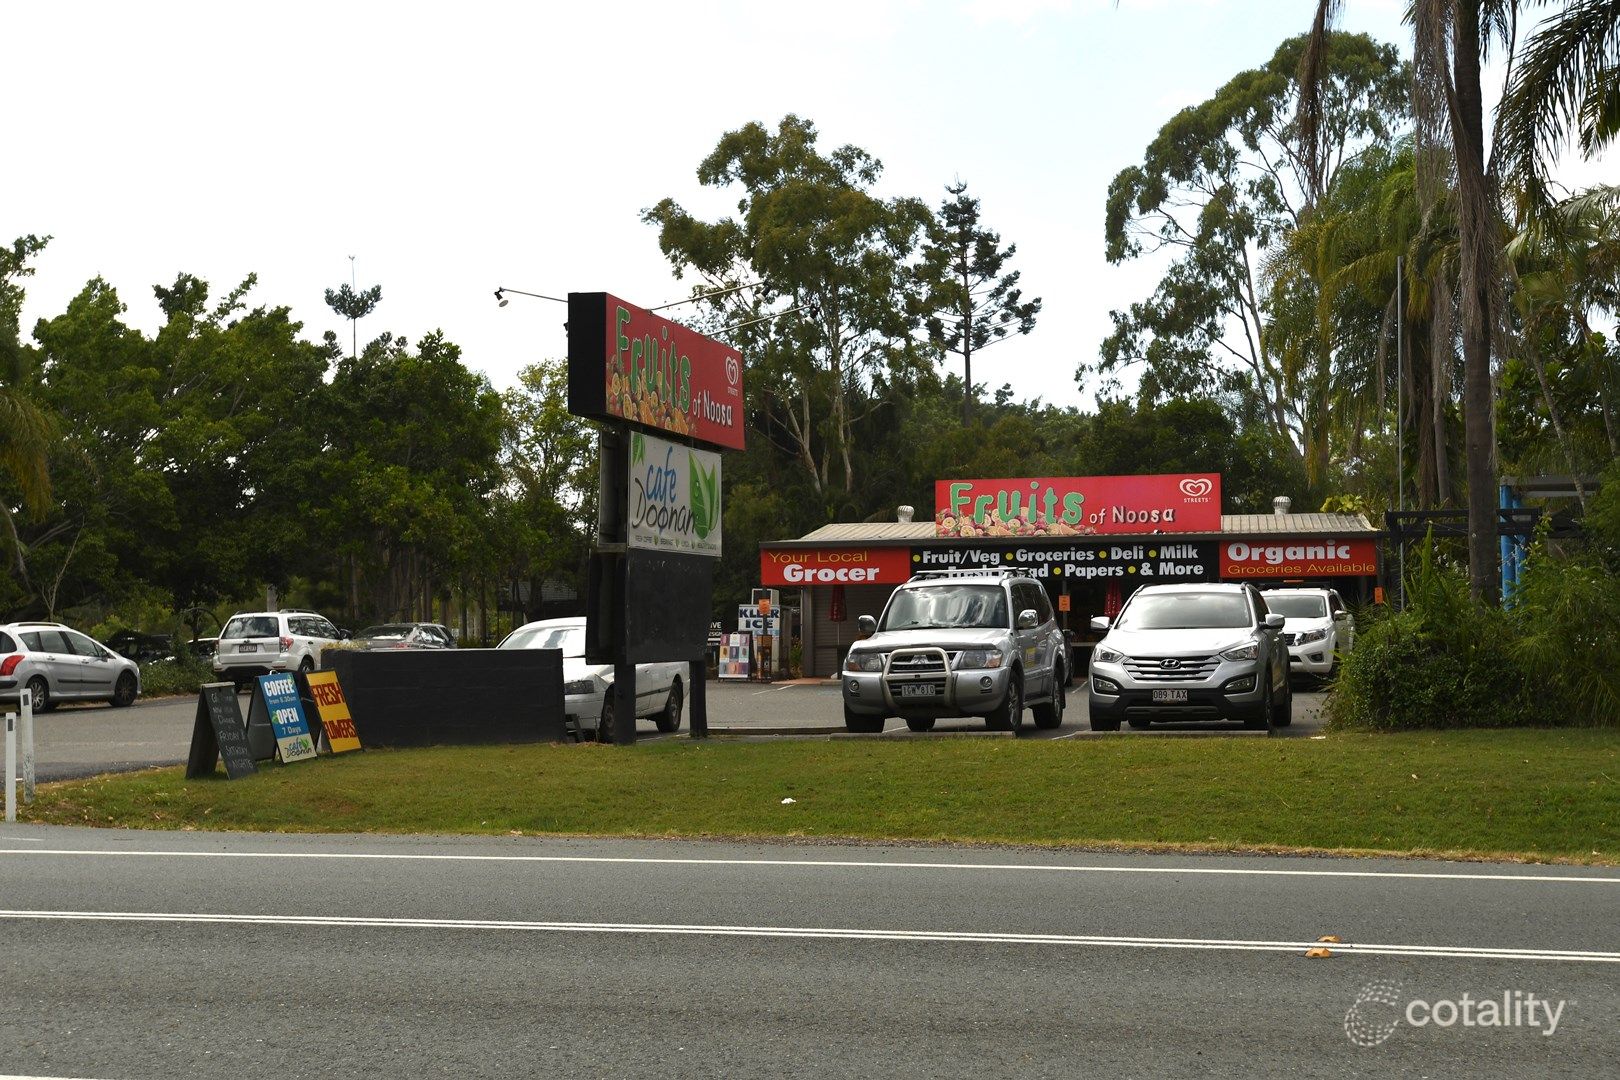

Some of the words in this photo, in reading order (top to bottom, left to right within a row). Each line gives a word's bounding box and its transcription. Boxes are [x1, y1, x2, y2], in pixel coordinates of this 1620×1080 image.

[616, 305, 691, 414] Fruits
[692, 391, 702, 417] of
[703, 389, 733, 426] Noosa
[631, 477, 695, 535] Doonan
[949, 481, 1085, 525] Fruits
[1089, 508, 1107, 524] of
[1112, 505, 1176, 523] Noosa
[768, 552, 811, 563] Your
[817, 550, 868, 562] Local
[922, 549, 1000, 565] Fruit/Veg
[1015, 548, 1095, 562] Groceries
[1110, 546, 1144, 560] Deli
[1160, 545, 1199, 559] Milk
[1227, 539, 1350, 565] Organic
[783, 564, 880, 582] Grocer
[1065, 562, 1124, 579] Papers
[1140, 563, 1153, 576] &
[1159, 562, 1204, 576] More
[1227, 564, 1302, 575] Groceries
[1306, 563, 1375, 573] Available
[746, 620, 774, 628] ICE
[264, 679, 295, 697] COFFEE
[310, 681, 346, 707] FRESH
[276, 707, 300, 725] OPEN
[288, 726, 302, 734] Days
